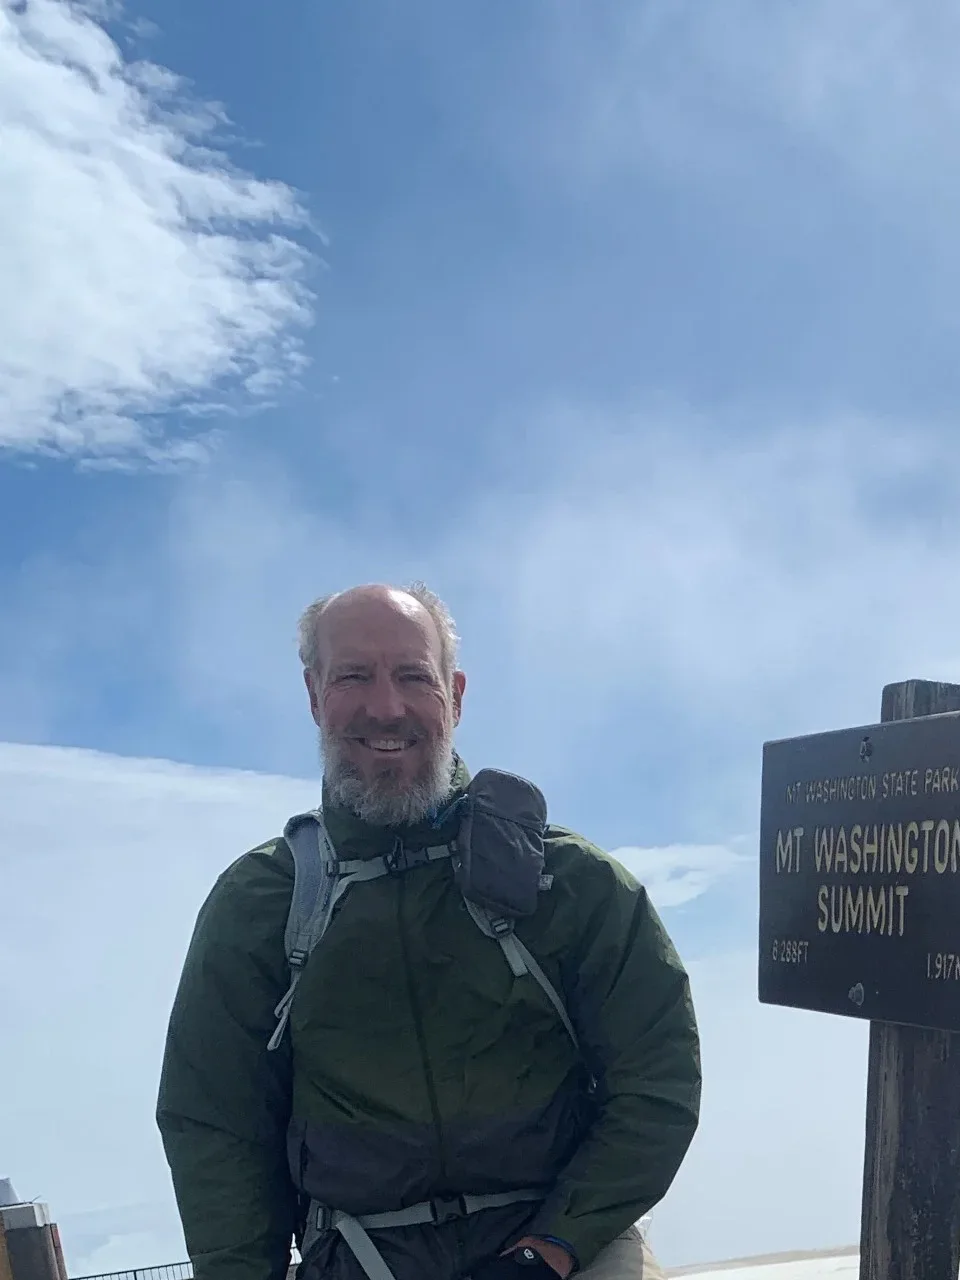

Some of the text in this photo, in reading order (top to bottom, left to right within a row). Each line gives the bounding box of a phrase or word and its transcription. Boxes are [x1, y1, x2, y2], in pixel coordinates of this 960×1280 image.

[807, 776, 876, 803] WASHINGTON
[882, 770, 918, 798] STATE
[925, 767, 959, 793] PARK
[776, 828, 804, 873] MT
[818, 885, 909, 936] SUMMIT
